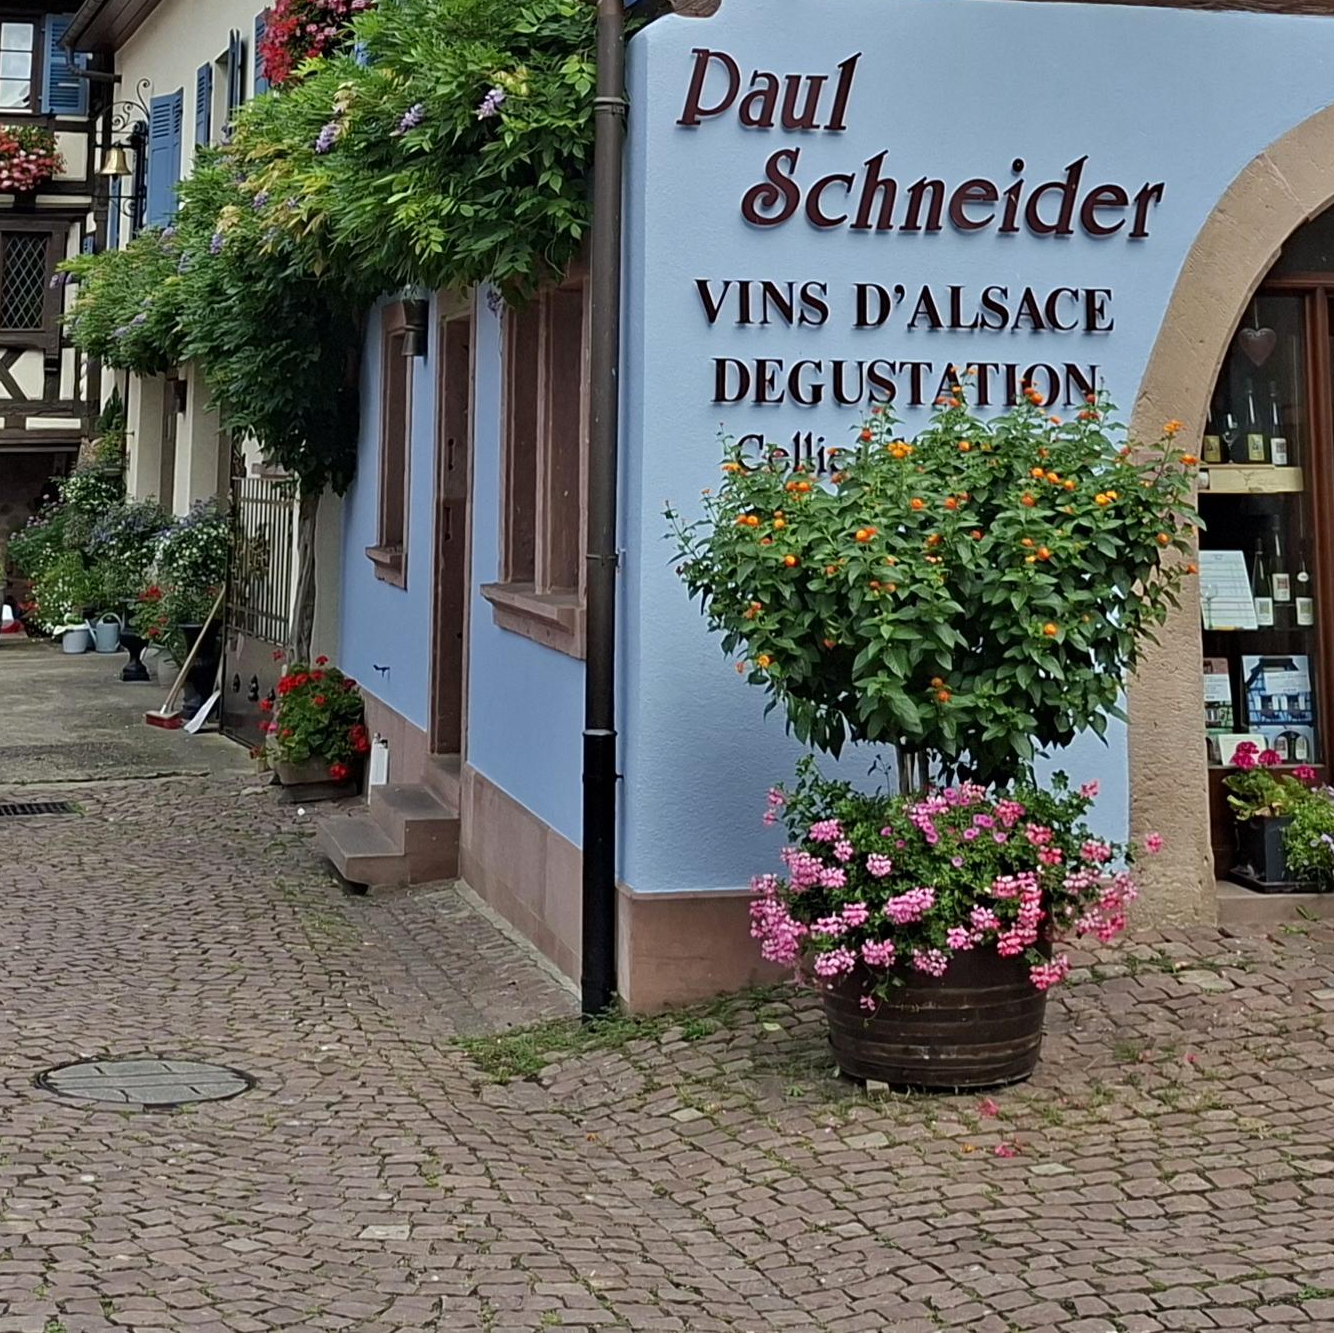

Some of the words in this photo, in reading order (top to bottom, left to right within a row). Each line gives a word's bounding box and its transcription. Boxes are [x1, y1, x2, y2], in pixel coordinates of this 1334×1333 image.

[676, 48, 862, 131] Paul
[741, 147, 1165, 238] Schneider
[695, 279, 829, 327] VINS
[712, 357, 1101, 408] DEGUSTATION
